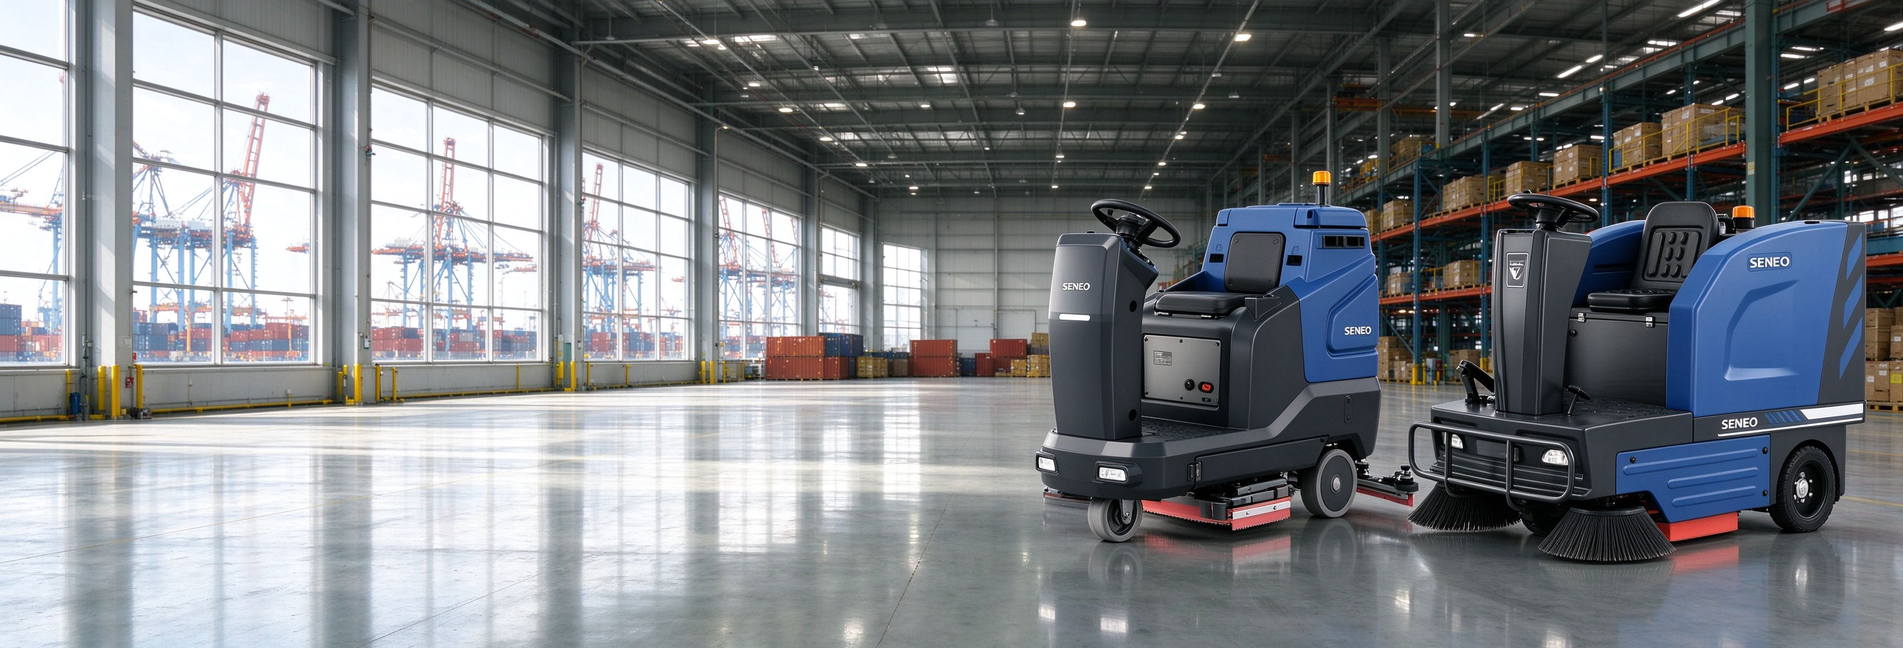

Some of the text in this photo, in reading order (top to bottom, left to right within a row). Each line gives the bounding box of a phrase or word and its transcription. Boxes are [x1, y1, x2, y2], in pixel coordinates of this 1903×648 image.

[1749, 256, 1790, 269] SENEO
[1062, 282, 1091, 291] SENEO
[1344, 326, 1372, 336] SENEO
[1721, 416, 1758, 430] SENEO
